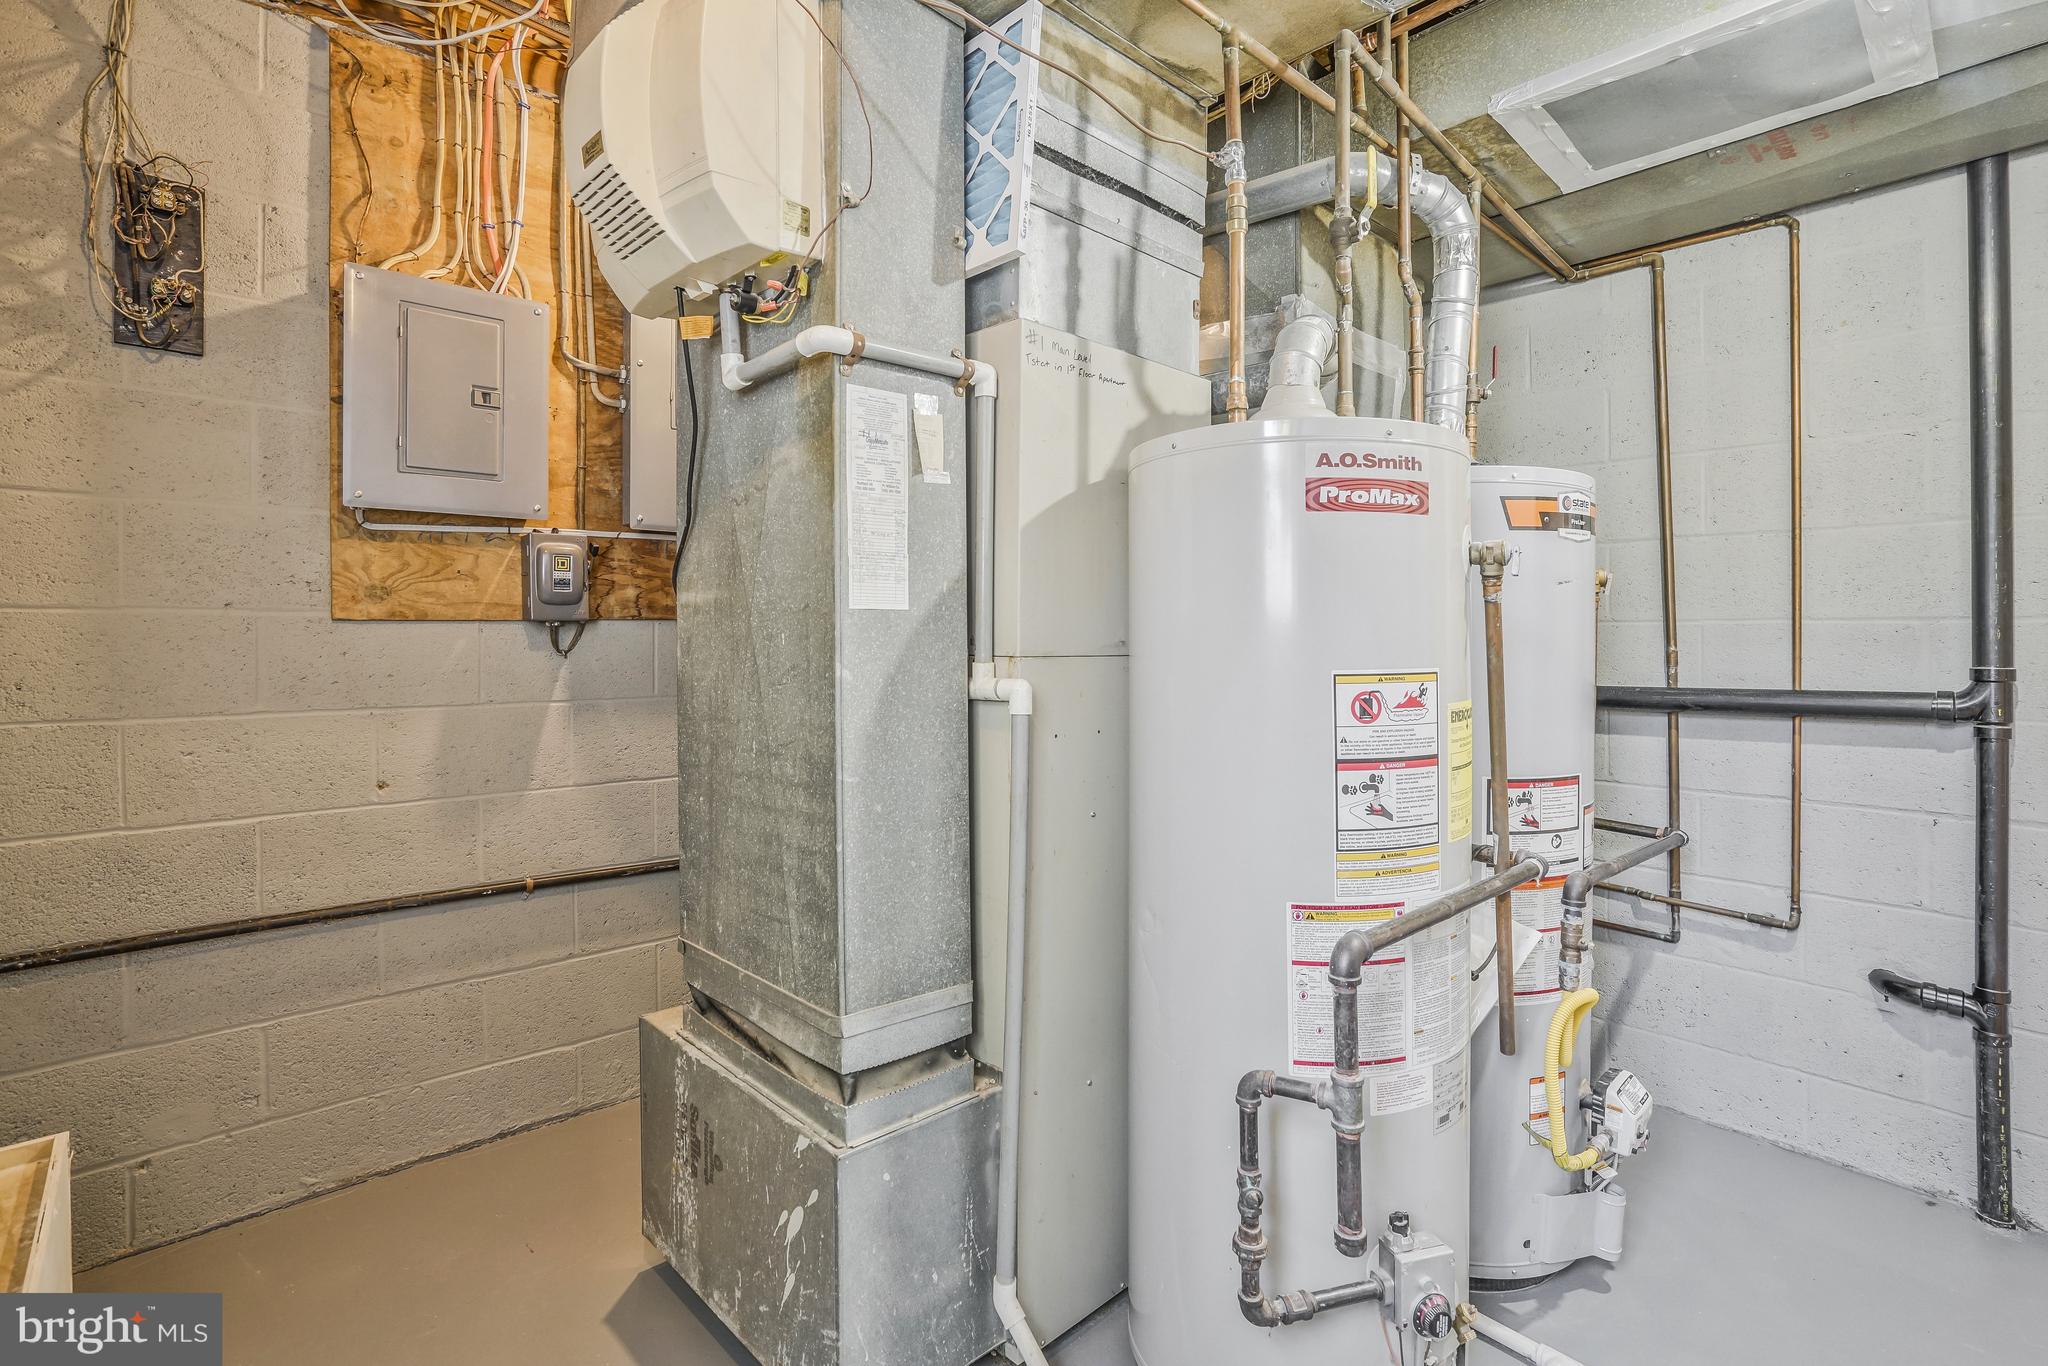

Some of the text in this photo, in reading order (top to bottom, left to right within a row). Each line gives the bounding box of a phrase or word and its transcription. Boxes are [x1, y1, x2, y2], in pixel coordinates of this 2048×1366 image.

[1073, 350, 1092, 364] Level
[1054, 363, 1063, 372] in
[1319, 486, 1420, 506] ProMax
[1572, 499, 1589, 509] state
[1381, 868, 1413, 876] ADVERTENCIA
